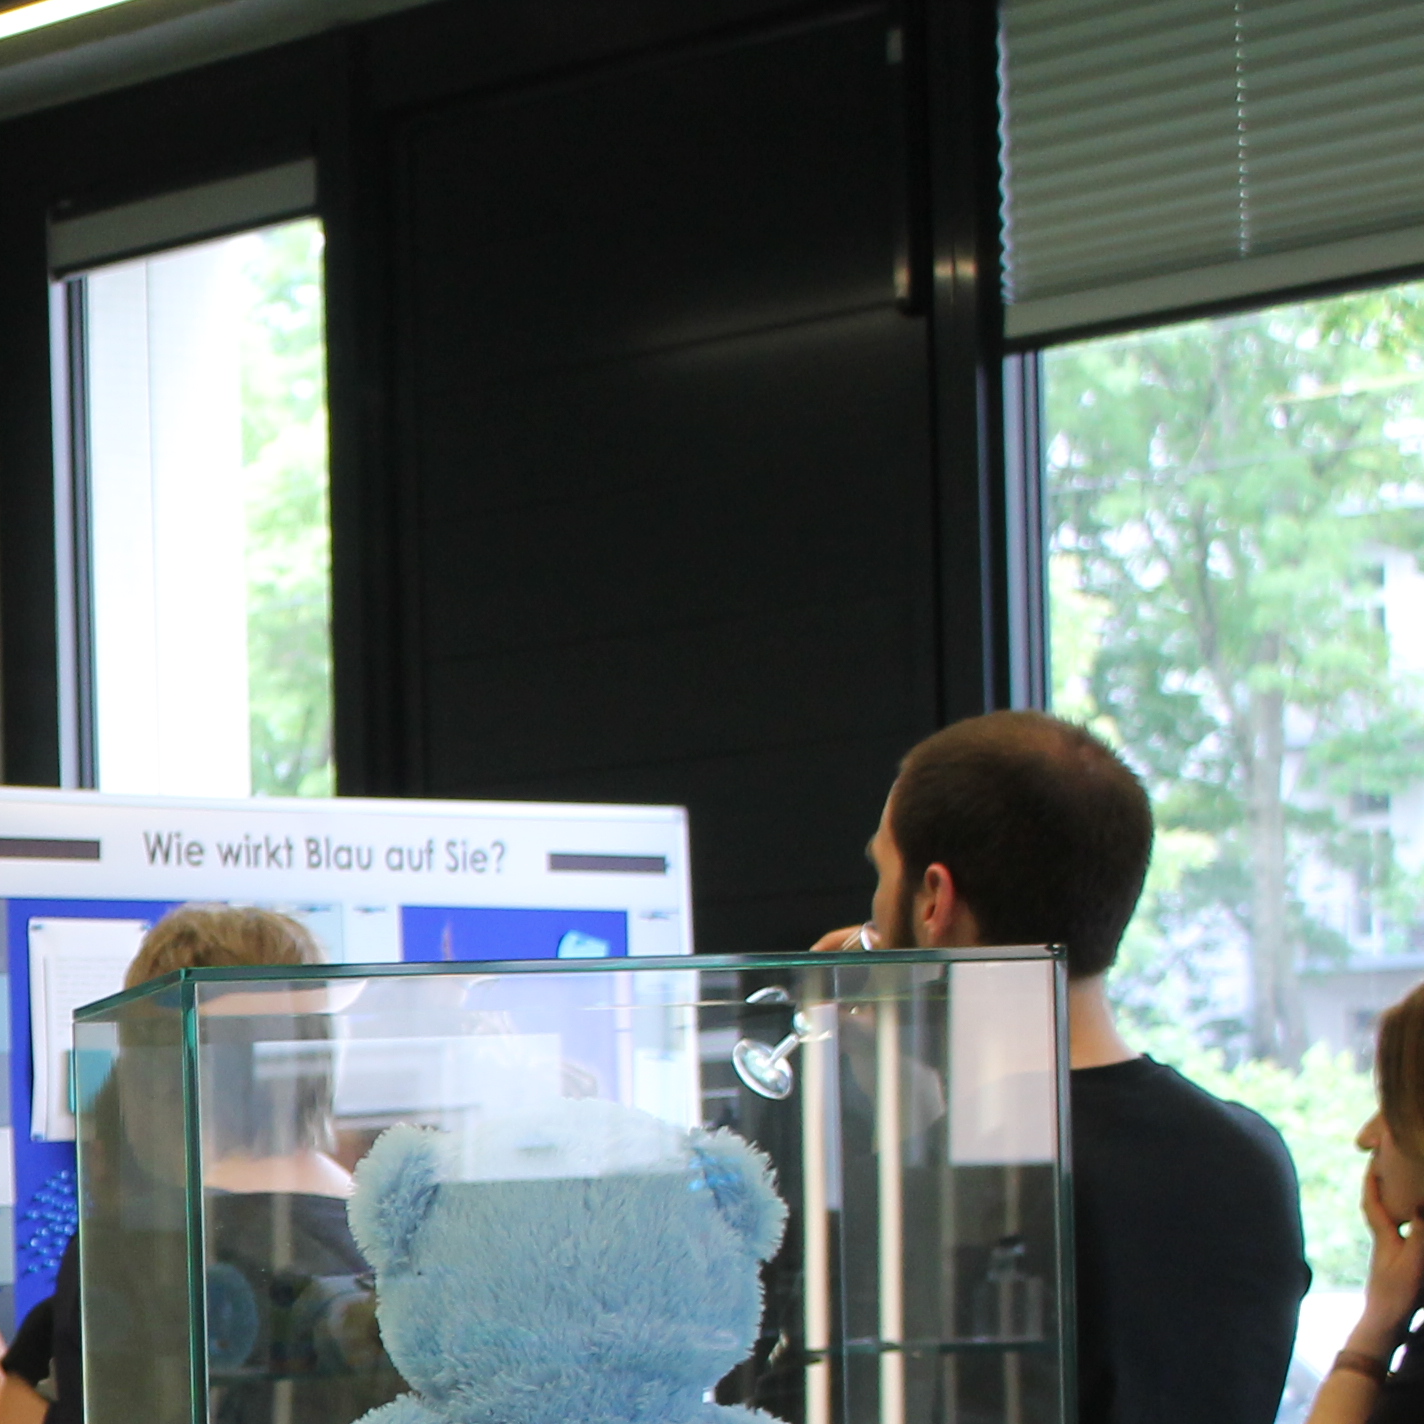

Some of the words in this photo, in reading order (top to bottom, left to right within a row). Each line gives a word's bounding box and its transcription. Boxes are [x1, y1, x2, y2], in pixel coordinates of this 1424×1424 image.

[144, 832, 206, 867] Wie
[217, 834, 294, 867] wirkt
[305, 836, 373, 871] Blau
[386, 839, 435, 872] auf
[446, 839, 506, 873] Sie?
